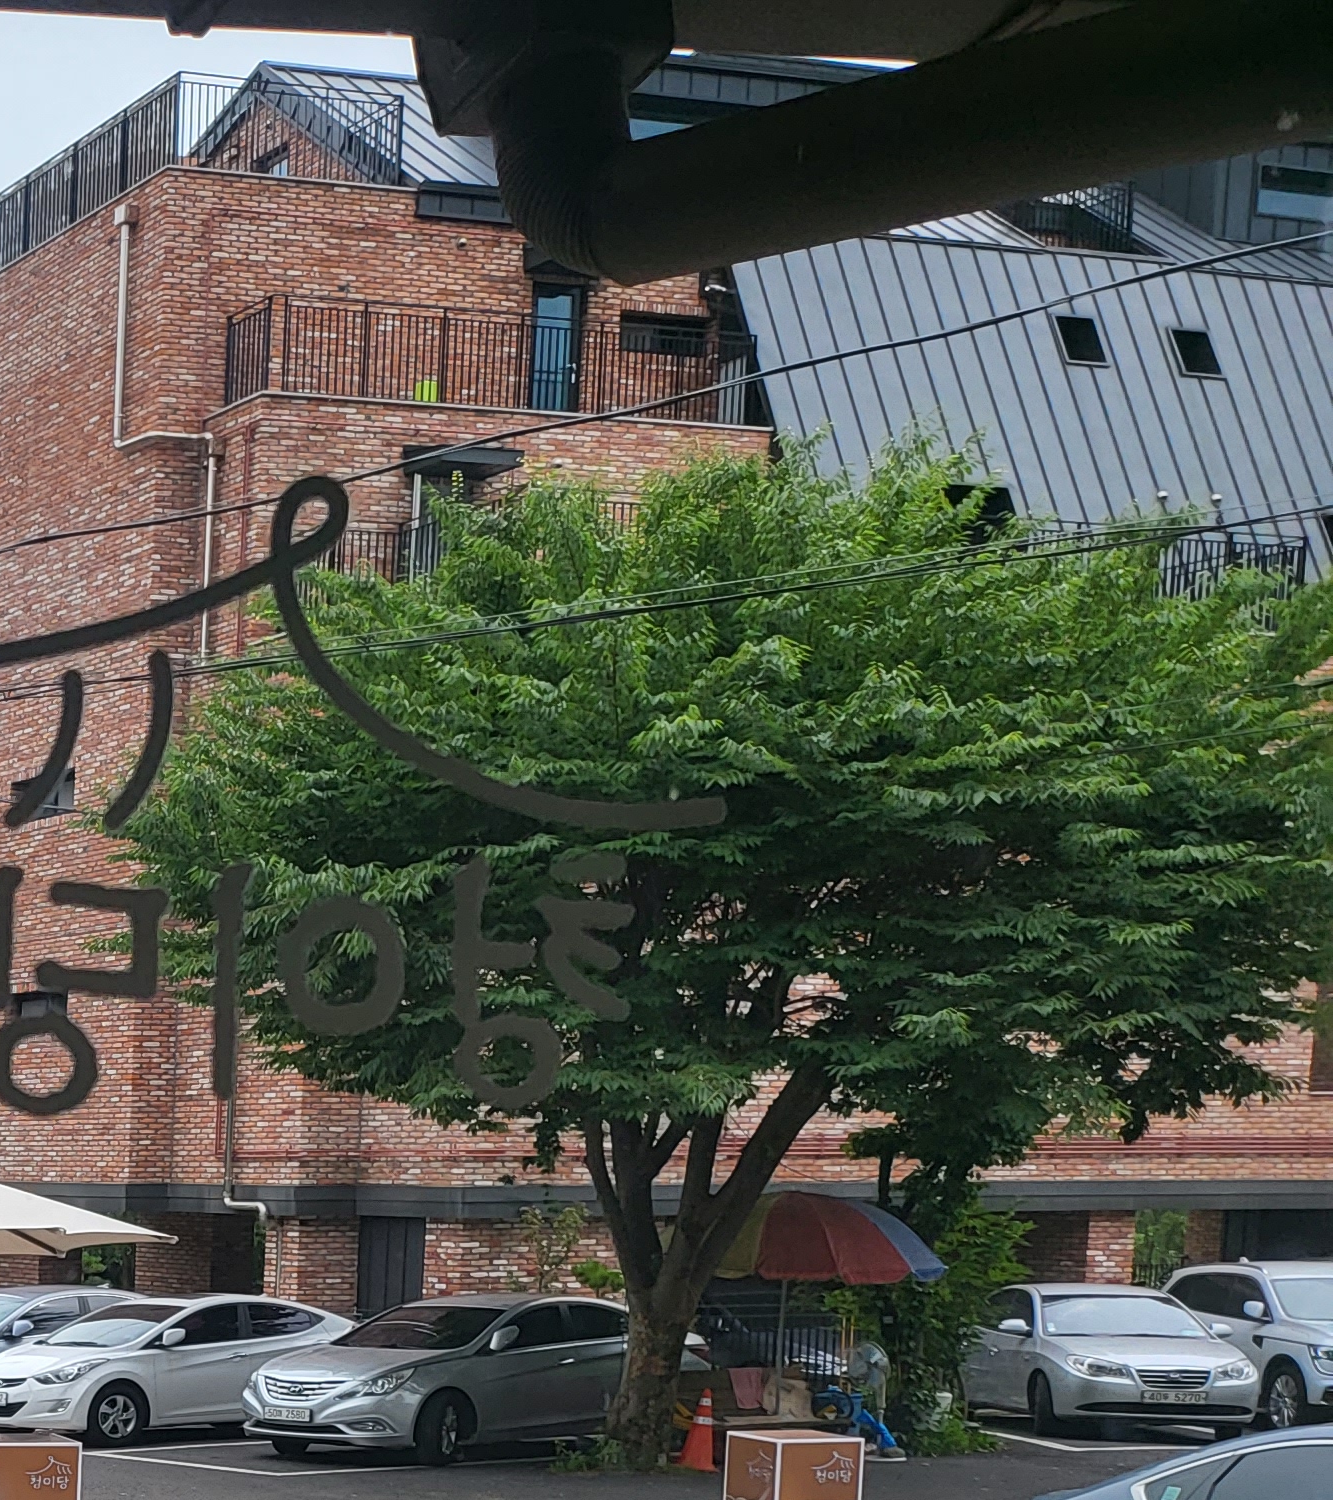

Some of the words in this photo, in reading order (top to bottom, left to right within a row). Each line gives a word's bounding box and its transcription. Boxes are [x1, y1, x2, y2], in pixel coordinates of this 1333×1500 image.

[1173, 1392, 1202, 1403] 5270
[285, 1409, 306, 1420] 2580
[30, 1475, 70, 1490] 청이당
